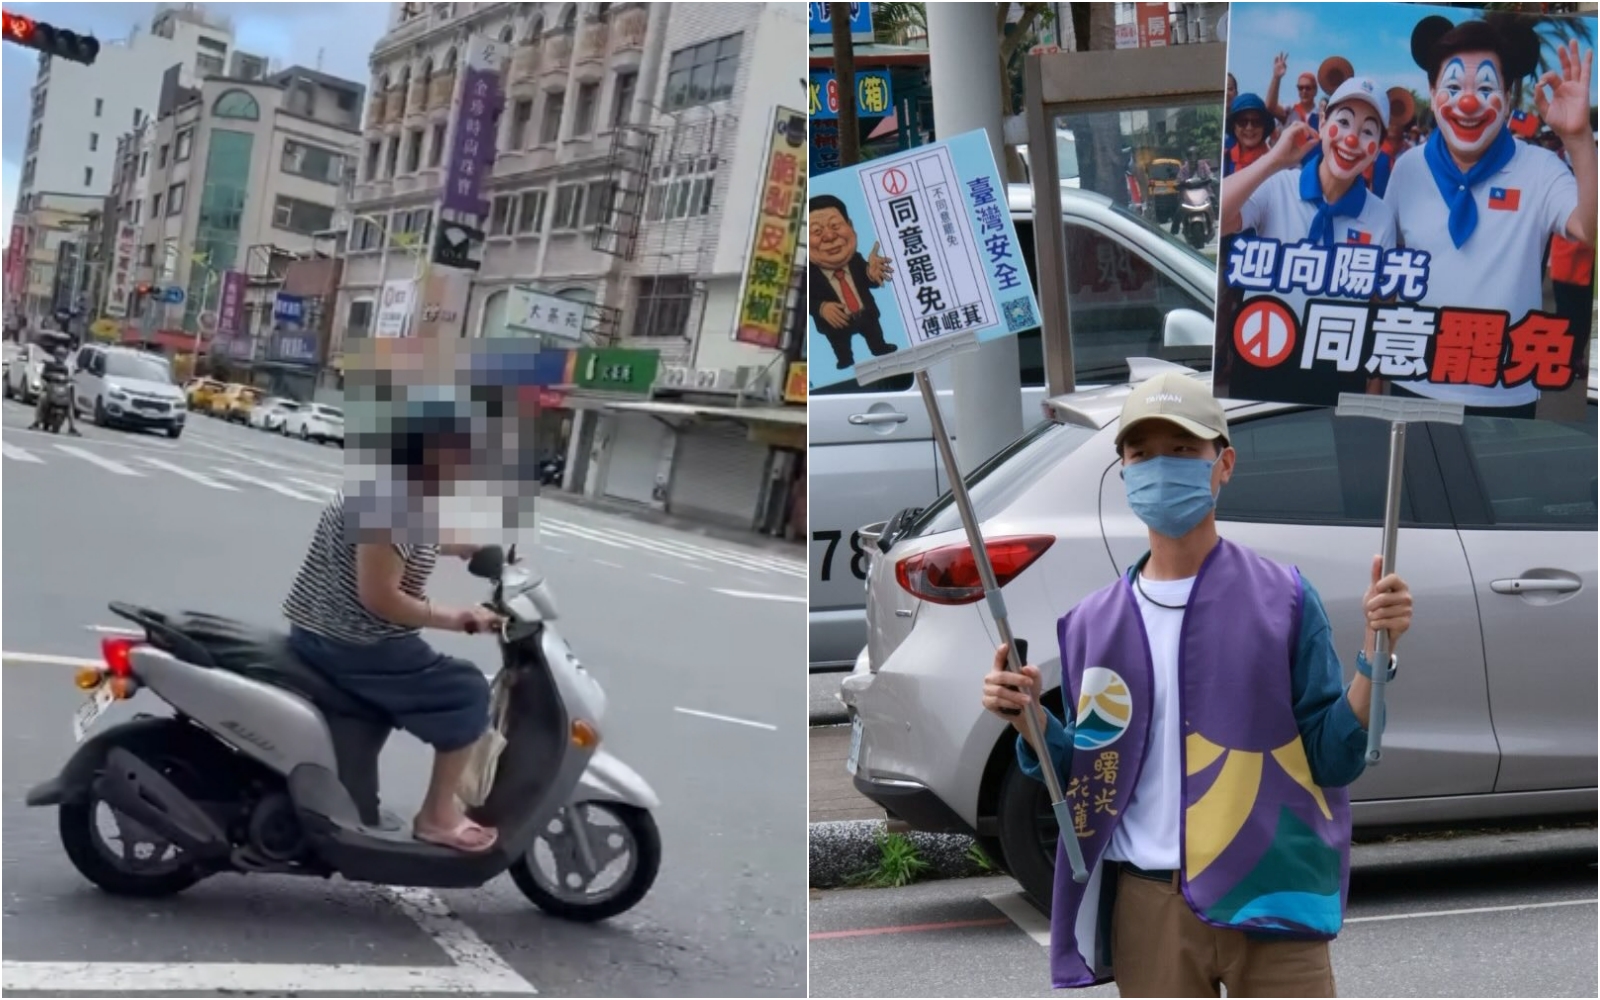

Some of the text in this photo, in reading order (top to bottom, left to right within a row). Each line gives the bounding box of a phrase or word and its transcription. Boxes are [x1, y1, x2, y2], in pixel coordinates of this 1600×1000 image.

[931, 187, 959, 248] 不同意罷免
[966, 175, 1022, 291] 臺灣安全
[888, 196, 946, 315] 同意罷免
[1227, 238, 1430, 297] 迎向陽光
[1300, 303, 1575, 387] 同意罷免
[1146, 393, 1182, 404] TAIWAN
[1066, 774, 1096, 837] 花蓮
[1093, 751, 1119, 816] 曙光
